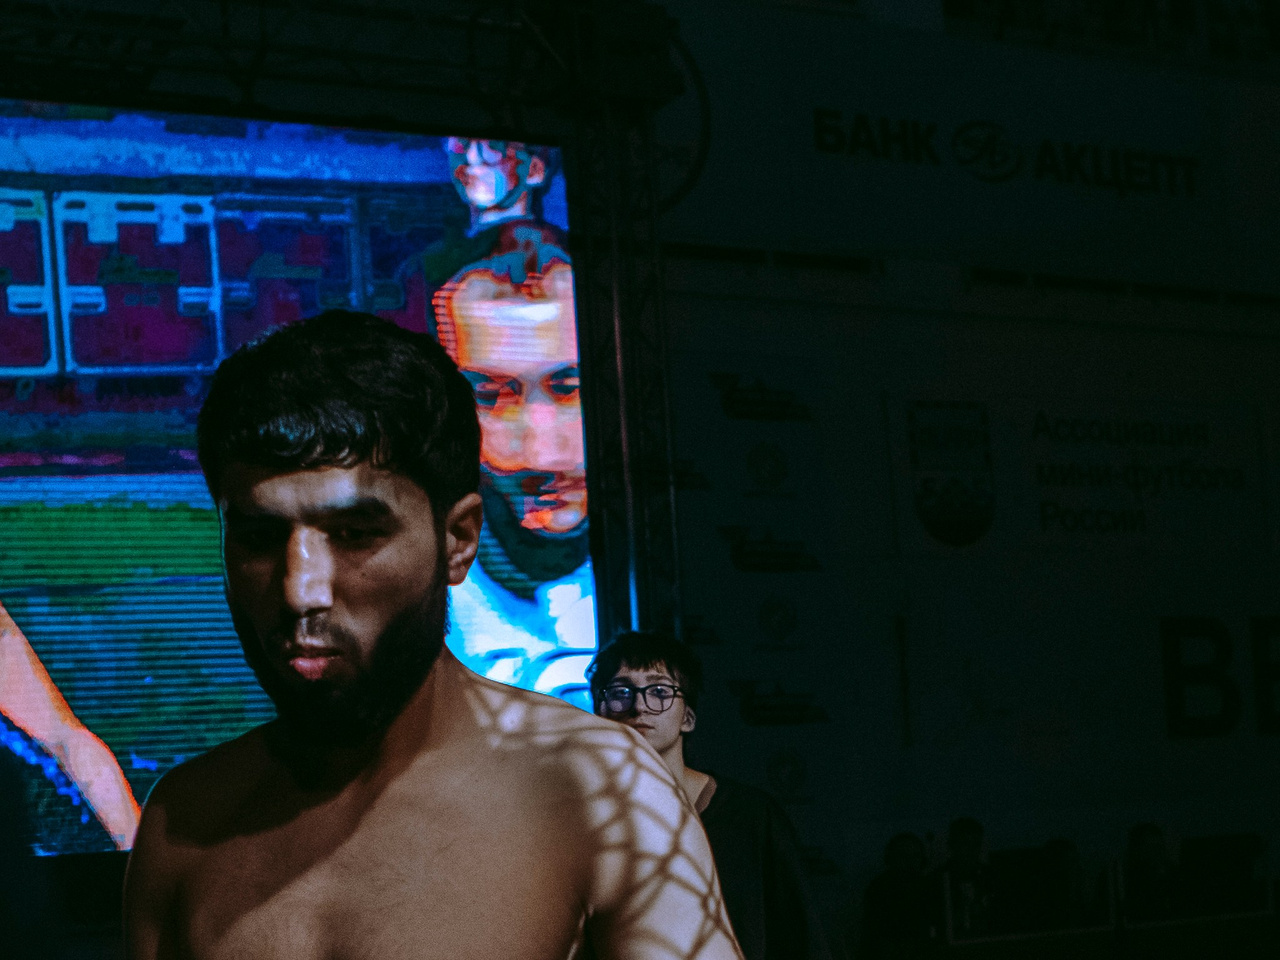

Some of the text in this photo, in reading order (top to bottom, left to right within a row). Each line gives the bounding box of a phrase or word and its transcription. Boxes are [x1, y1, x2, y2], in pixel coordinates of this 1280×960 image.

[813, 107, 1200, 198] БАНК АКЦЕПТ
[1032, 409, 1210, 448] Ассоциация
[1035, 454, 1246, 500] мини-футбола
[1039, 501, 1147, 534] России
